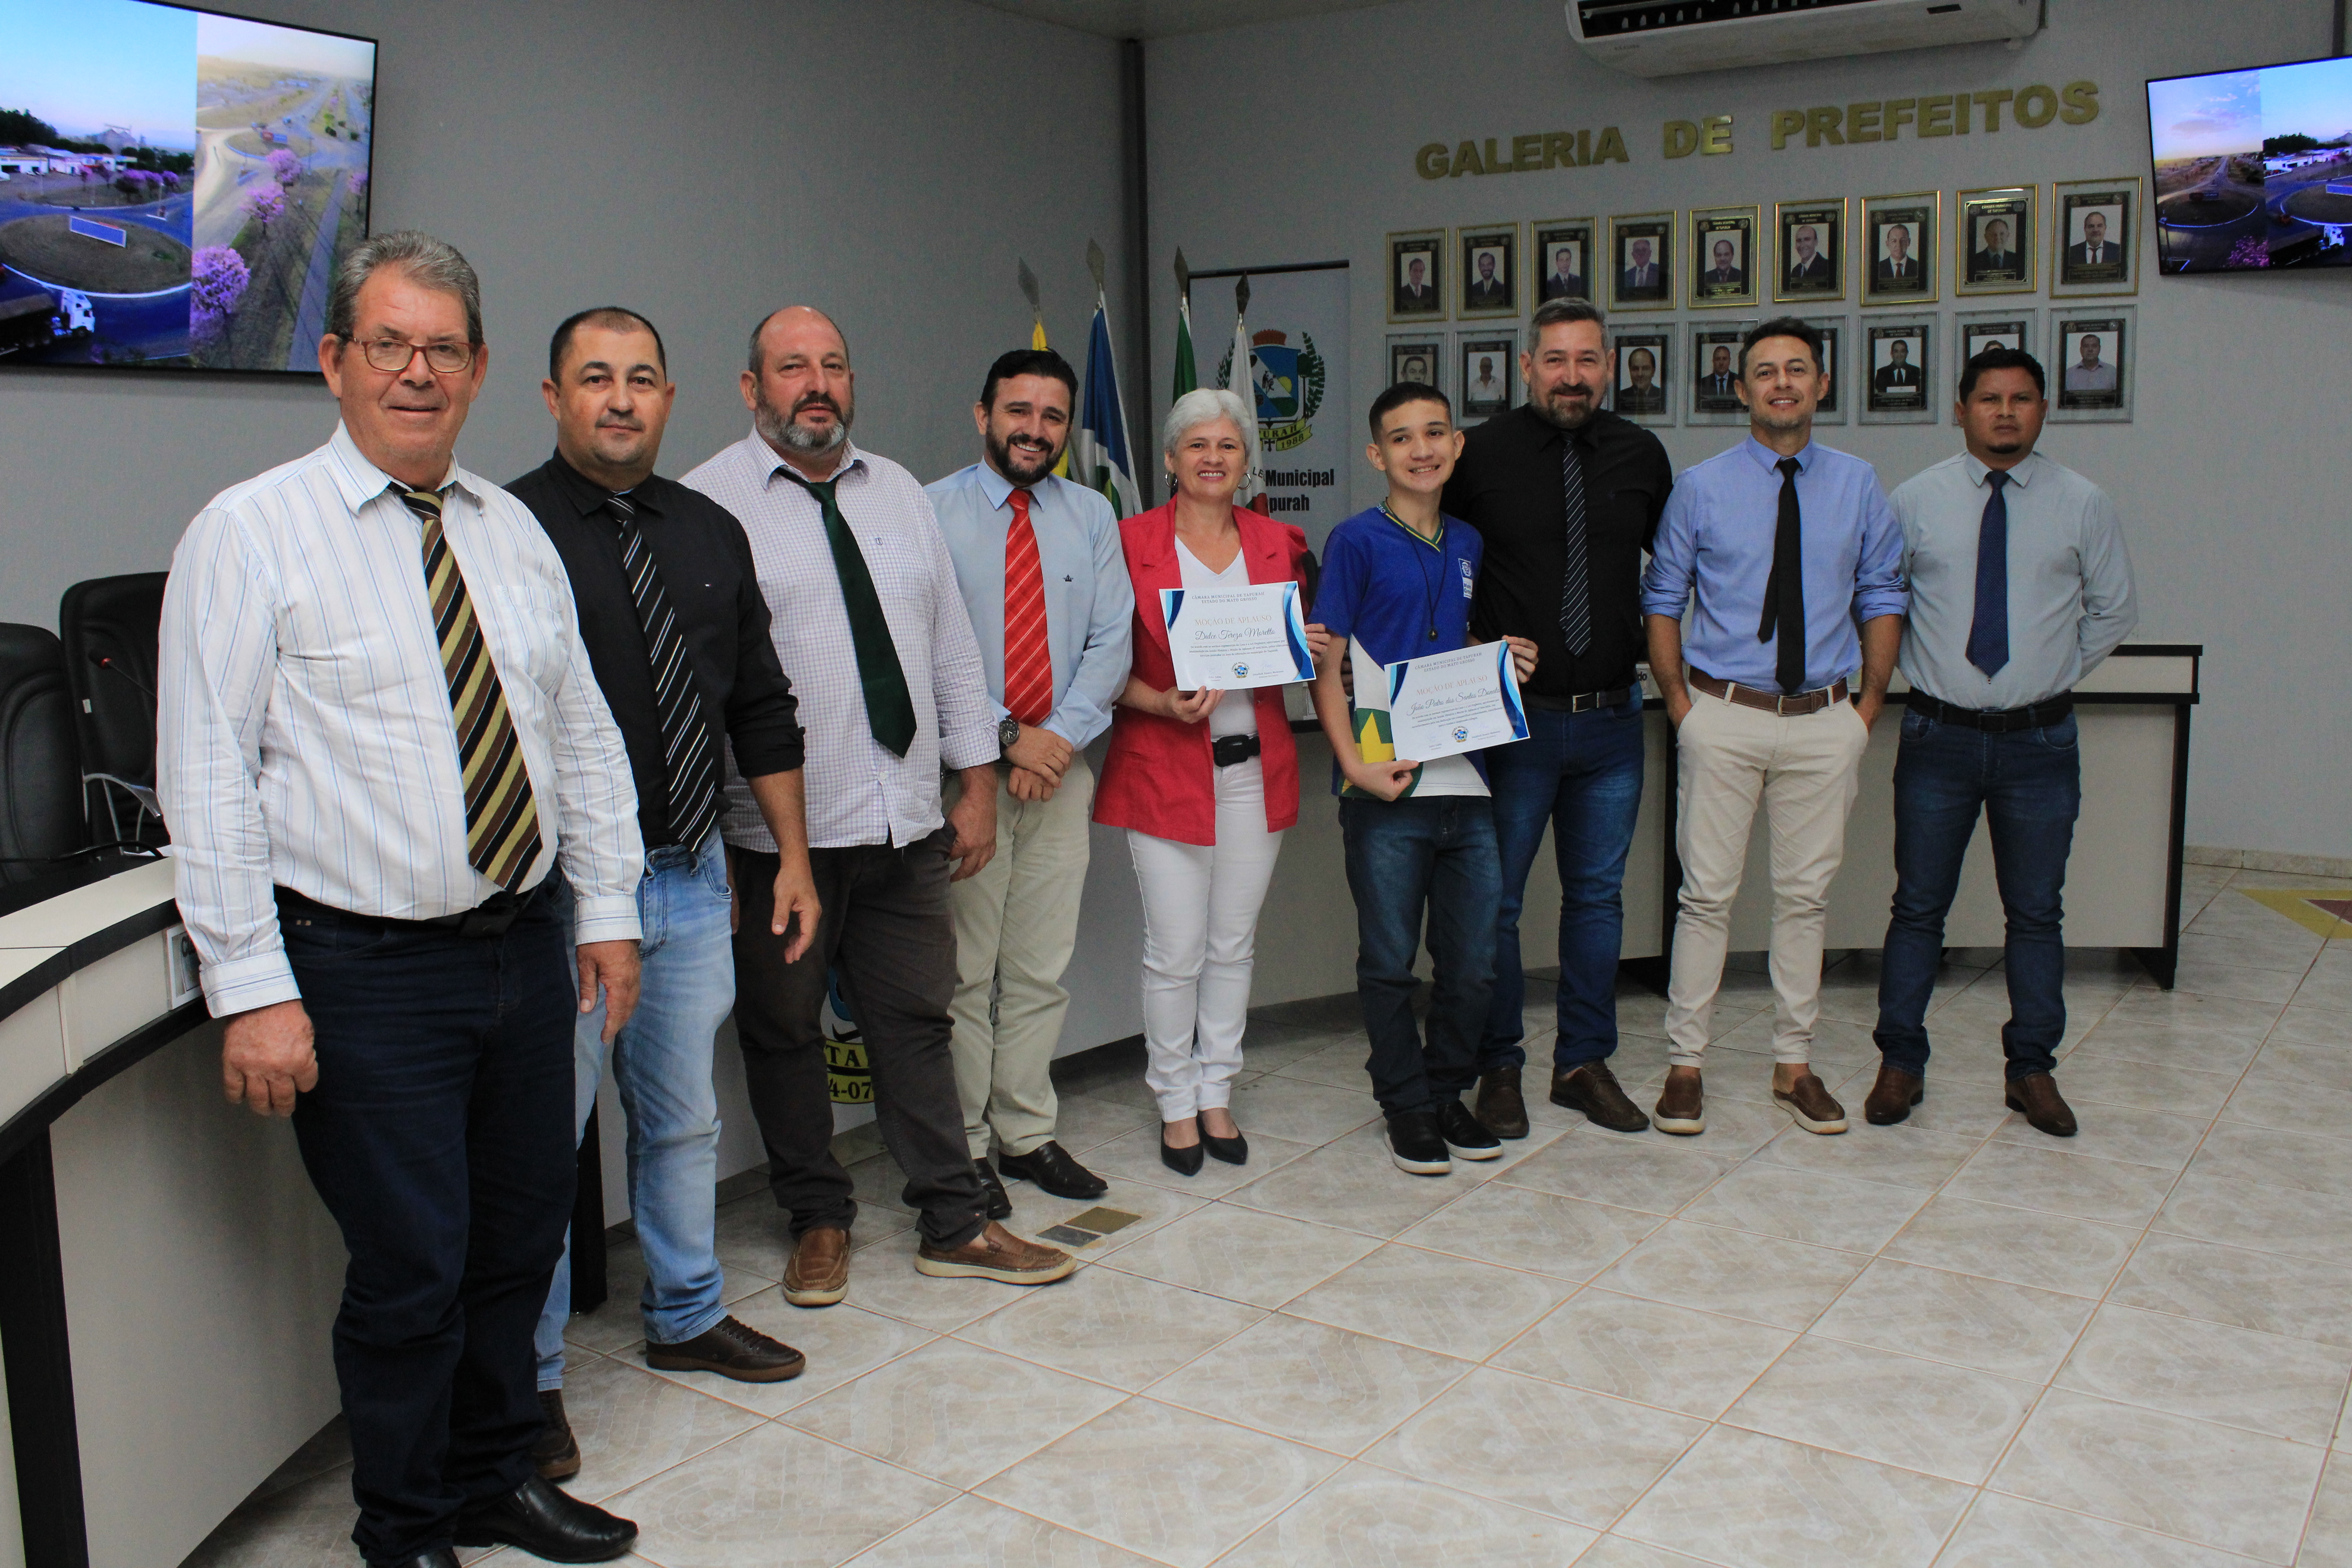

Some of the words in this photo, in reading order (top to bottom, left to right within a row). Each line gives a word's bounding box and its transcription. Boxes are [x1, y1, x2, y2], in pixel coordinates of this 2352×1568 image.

[1416, 127, 1628, 180] GALERIA
[1664, 116, 1733, 159] DE
[1771, 80, 2100, 149] PREFEITOS
[1281, 433, 1303, 448] 1988
[1265, 468, 1334, 488] Municipal
[1195, 618, 1223, 626] MOÇÃO
[1237, 615, 1272, 623] APLAUSO
[1195, 630, 1217, 640] Dulce
[1218, 630, 1243, 641] Tereza
[1244, 627, 1275, 637] Moretto
[1416, 684, 1443, 696] MOÇÃO
[1456, 675, 1488, 687] APLAUSO
[1406, 702, 1424, 716] João
[1425, 699, 1444, 709] Pedro
[1455, 692, 1476, 702] Santos
[1478, 687, 1500, 697] Donato
